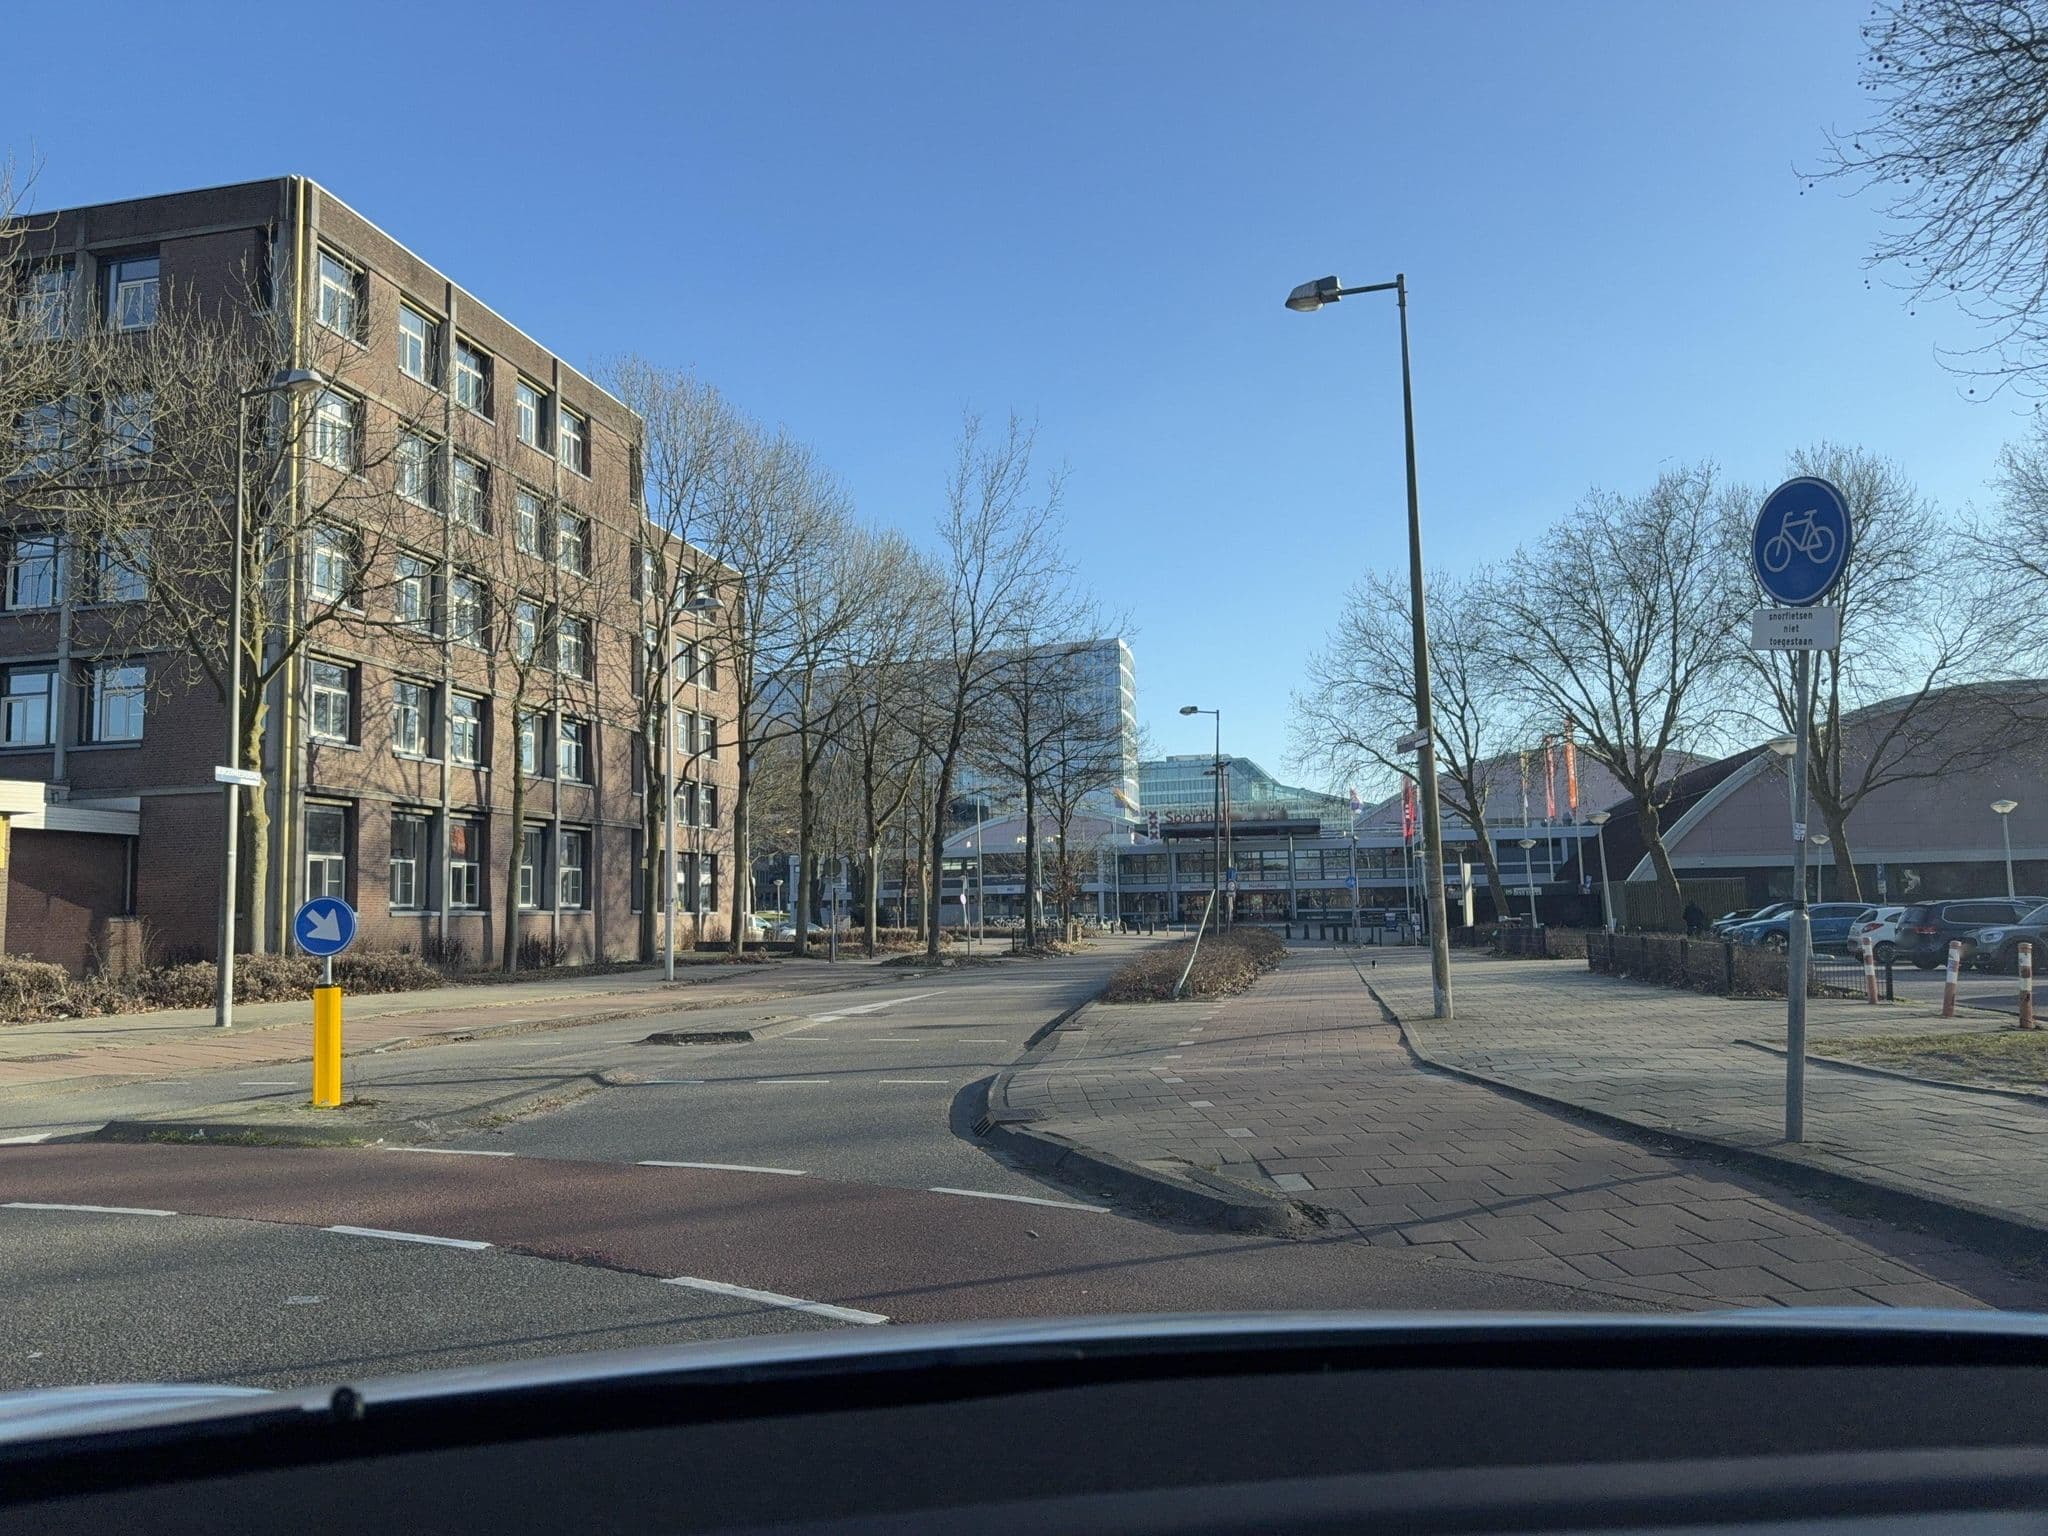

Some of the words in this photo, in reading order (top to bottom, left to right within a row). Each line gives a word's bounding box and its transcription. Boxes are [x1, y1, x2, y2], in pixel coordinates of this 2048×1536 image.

[1769, 612, 1813, 621] snorfietsen
[1783, 624, 1799, 632] niet
[1769, 637, 1813, 648] toegestaan
